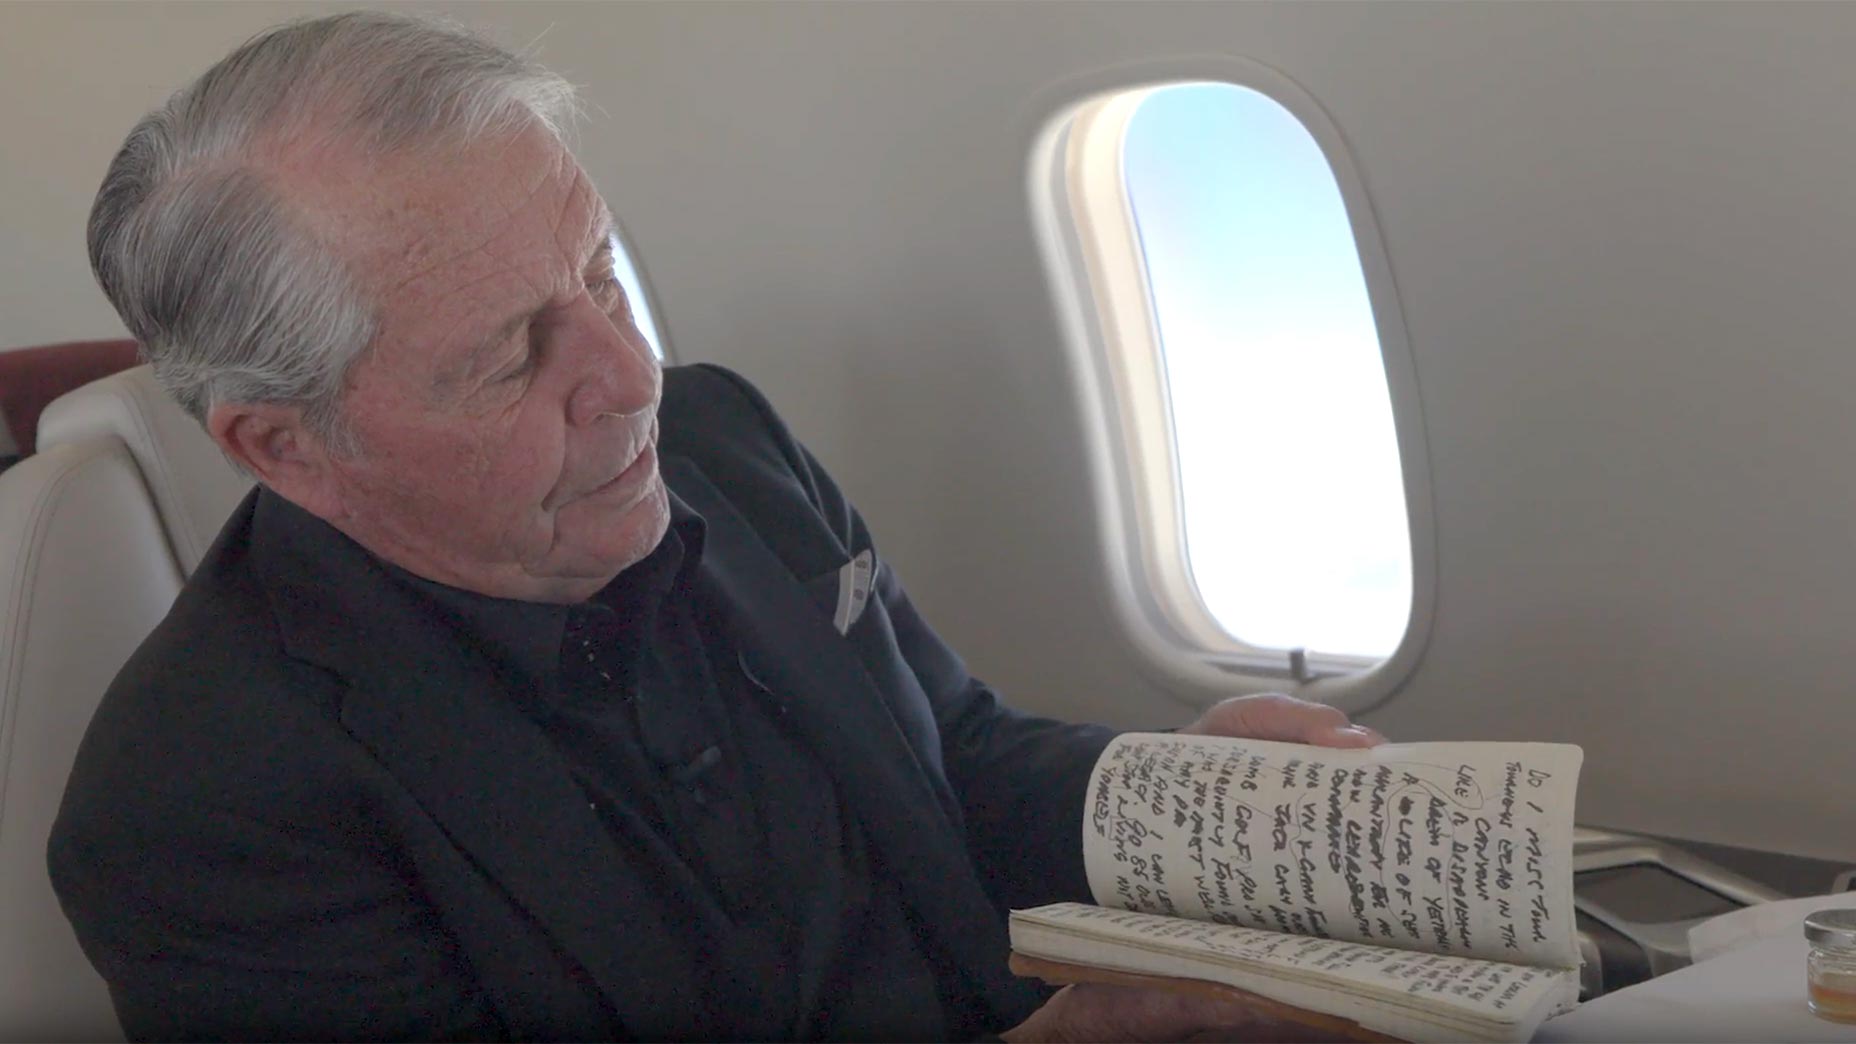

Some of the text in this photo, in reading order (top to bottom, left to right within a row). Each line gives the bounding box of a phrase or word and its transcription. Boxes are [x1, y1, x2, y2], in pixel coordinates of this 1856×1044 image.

[1152, 776, 1168, 816] AND
[1233, 805, 1253, 861] GOLF
[1395, 872, 1412, 906] OF
[1497, 898, 1512, 919] IN
